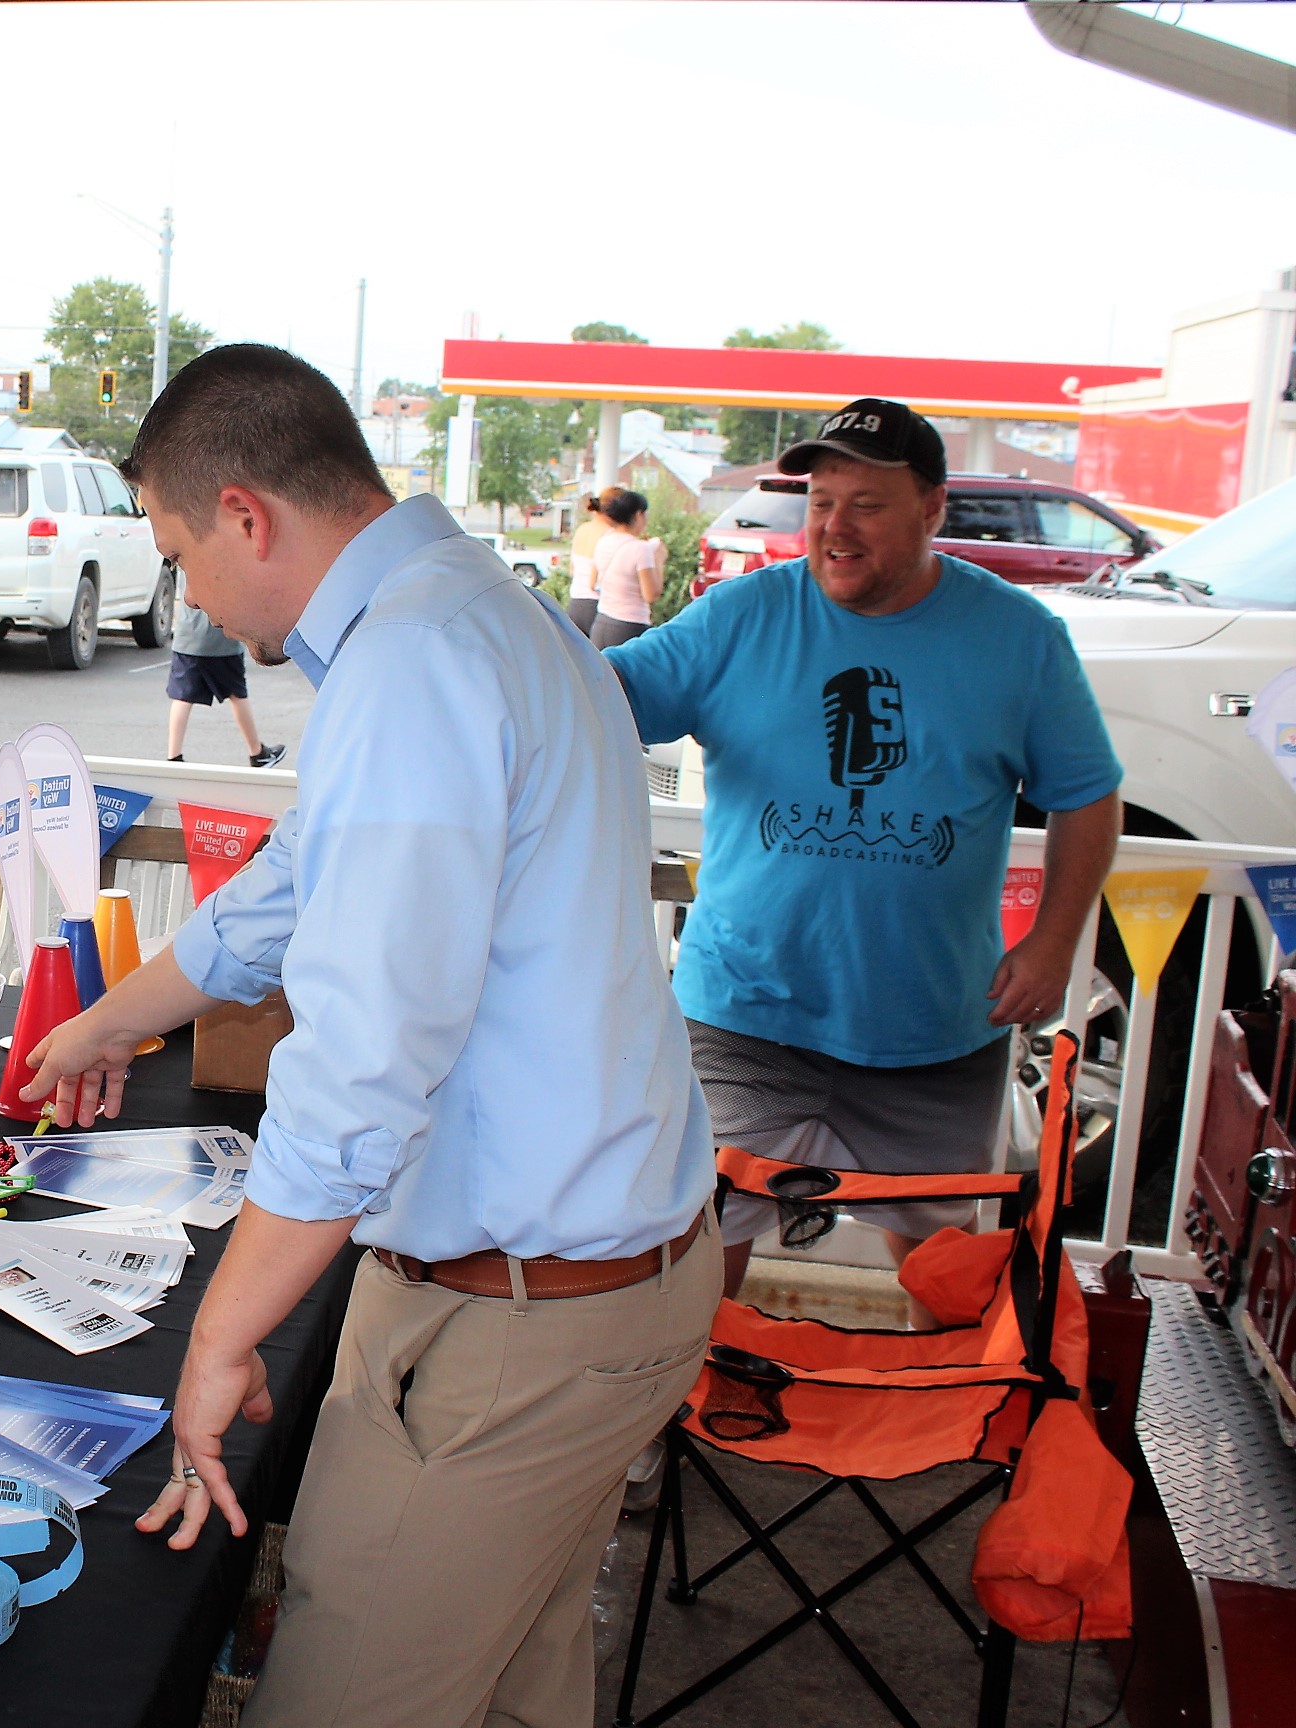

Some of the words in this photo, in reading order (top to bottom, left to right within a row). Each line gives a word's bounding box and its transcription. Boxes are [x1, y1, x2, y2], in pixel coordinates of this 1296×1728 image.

[868, 685, 904, 743] S
[97, 794, 127, 811] UNITED
[789, 803, 924, 833] SHAKE
[195, 819, 214, 832] LIVE
[215, 822, 247, 837] UNITED
[195, 834, 221, 845] United
[204, 844, 220, 856] Way
[781, 844, 925, 865] BROADCASTING
[83, 1318, 100, 1327] Way
[88, 1317, 114, 1330] United
[106, 1321, 124, 1332] LIVE
[76, 1328, 105, 1340] UNITED
[58, 1499, 74, 1515] ONE
[53, 1506, 76, 1530] ADMIT
